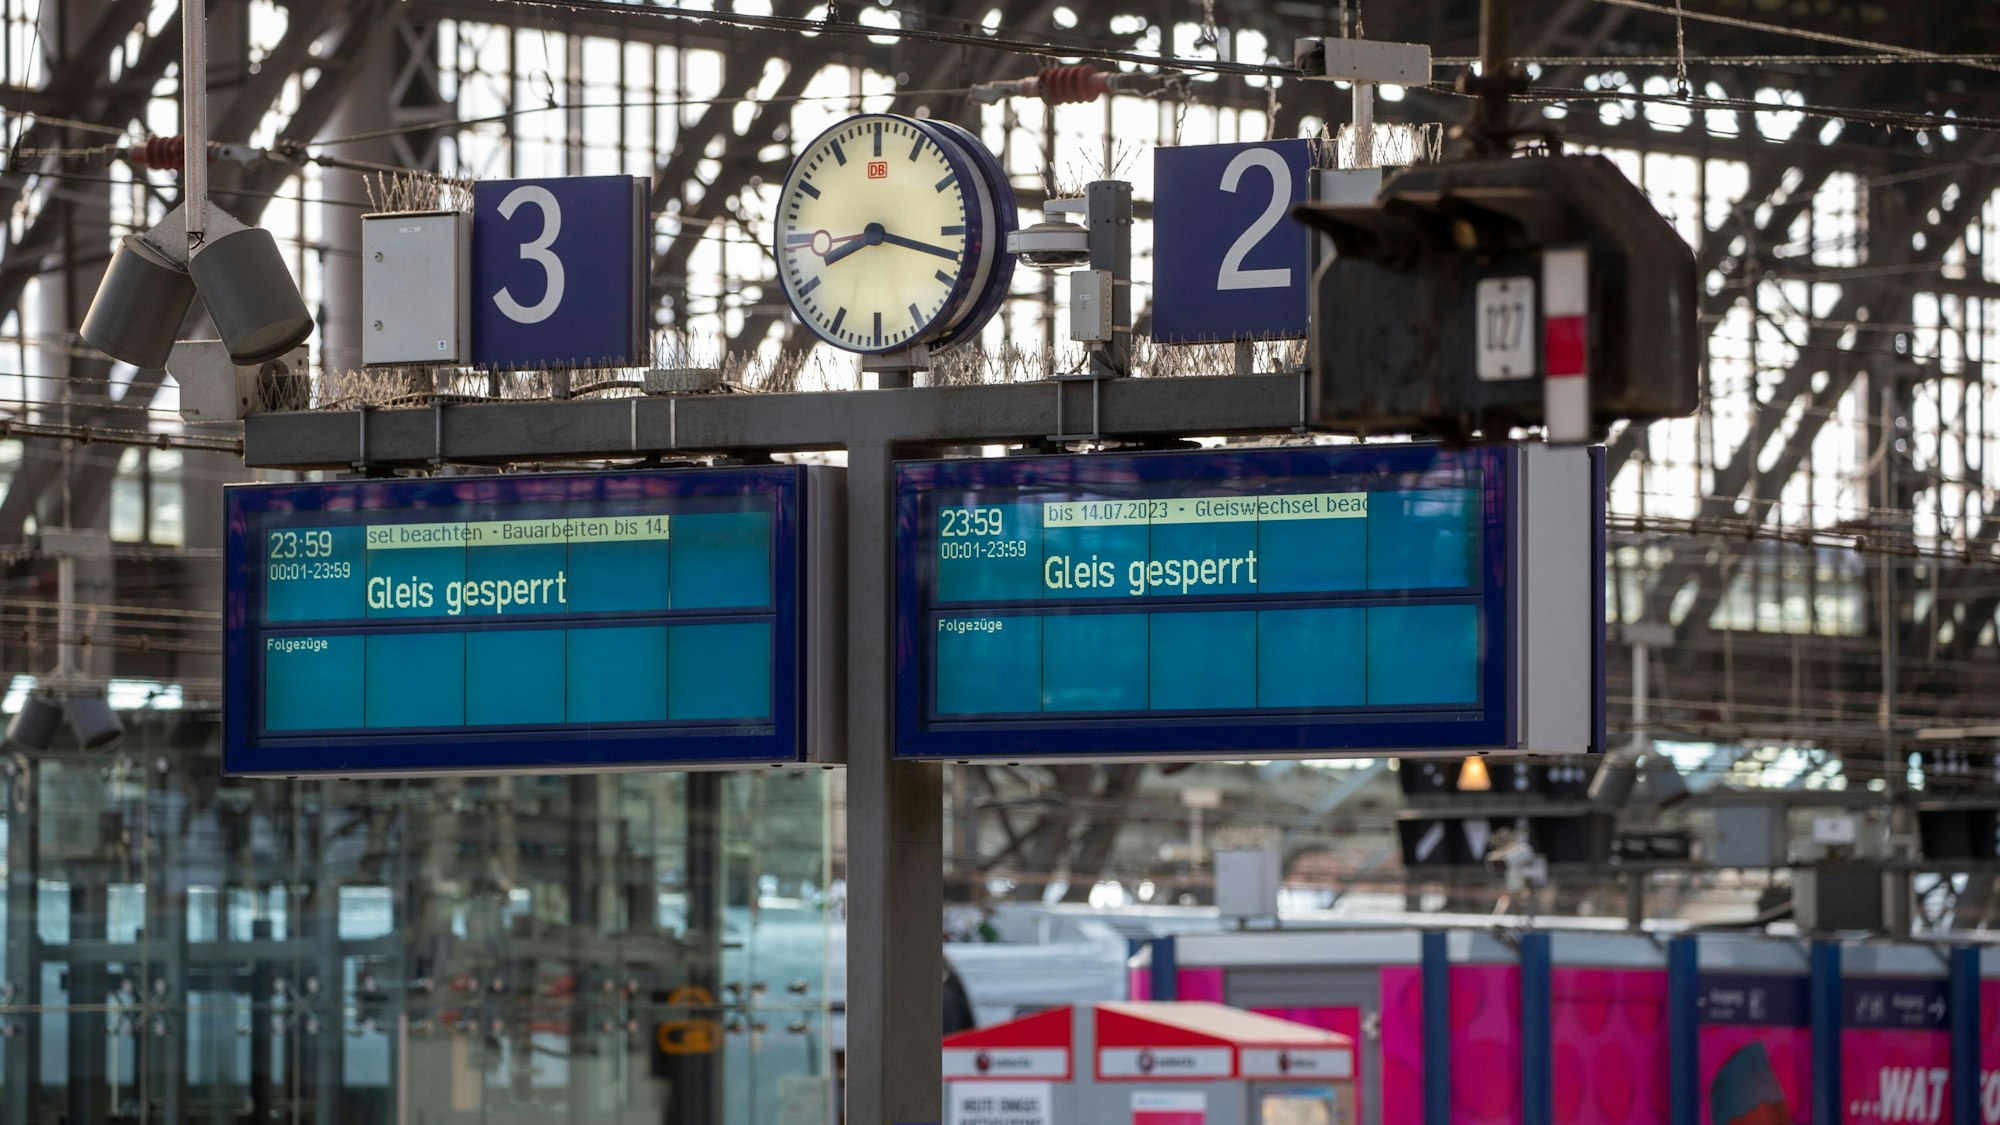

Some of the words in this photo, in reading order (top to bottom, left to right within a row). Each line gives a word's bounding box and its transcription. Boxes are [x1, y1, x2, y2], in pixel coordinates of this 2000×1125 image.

[869, 163, 886, 177] DB
[1217, 147, 1292, 291] 2
[493, 185, 565, 324] 3
[1048, 505, 1073, 522] bis
[1081, 502, 1168, 520] 14.07.2023
[1195, 497, 1320, 517] Gleiswechsel
[368, 527, 394, 544] sel
[400, 524, 483, 542] beachten
[503, 520, 608, 540] Bauarbeiten
[614, 519, 638, 536] bis
[941, 508, 1003, 537] 23:59
[271, 530, 333, 559] 23:59
[941, 540, 1027, 559] 00:01-23:59
[270, 561, 350, 581] 00:01-23:59
[1044, 554, 1115, 589] Gleis
[1128, 549, 1257, 596] gesperrt
[367, 575, 434, 609] Gleis
[446, 570, 567, 616] gesperrt
[938, 618, 1003, 634] Folgezüge
[267, 638, 328, 653] Folgezüge
